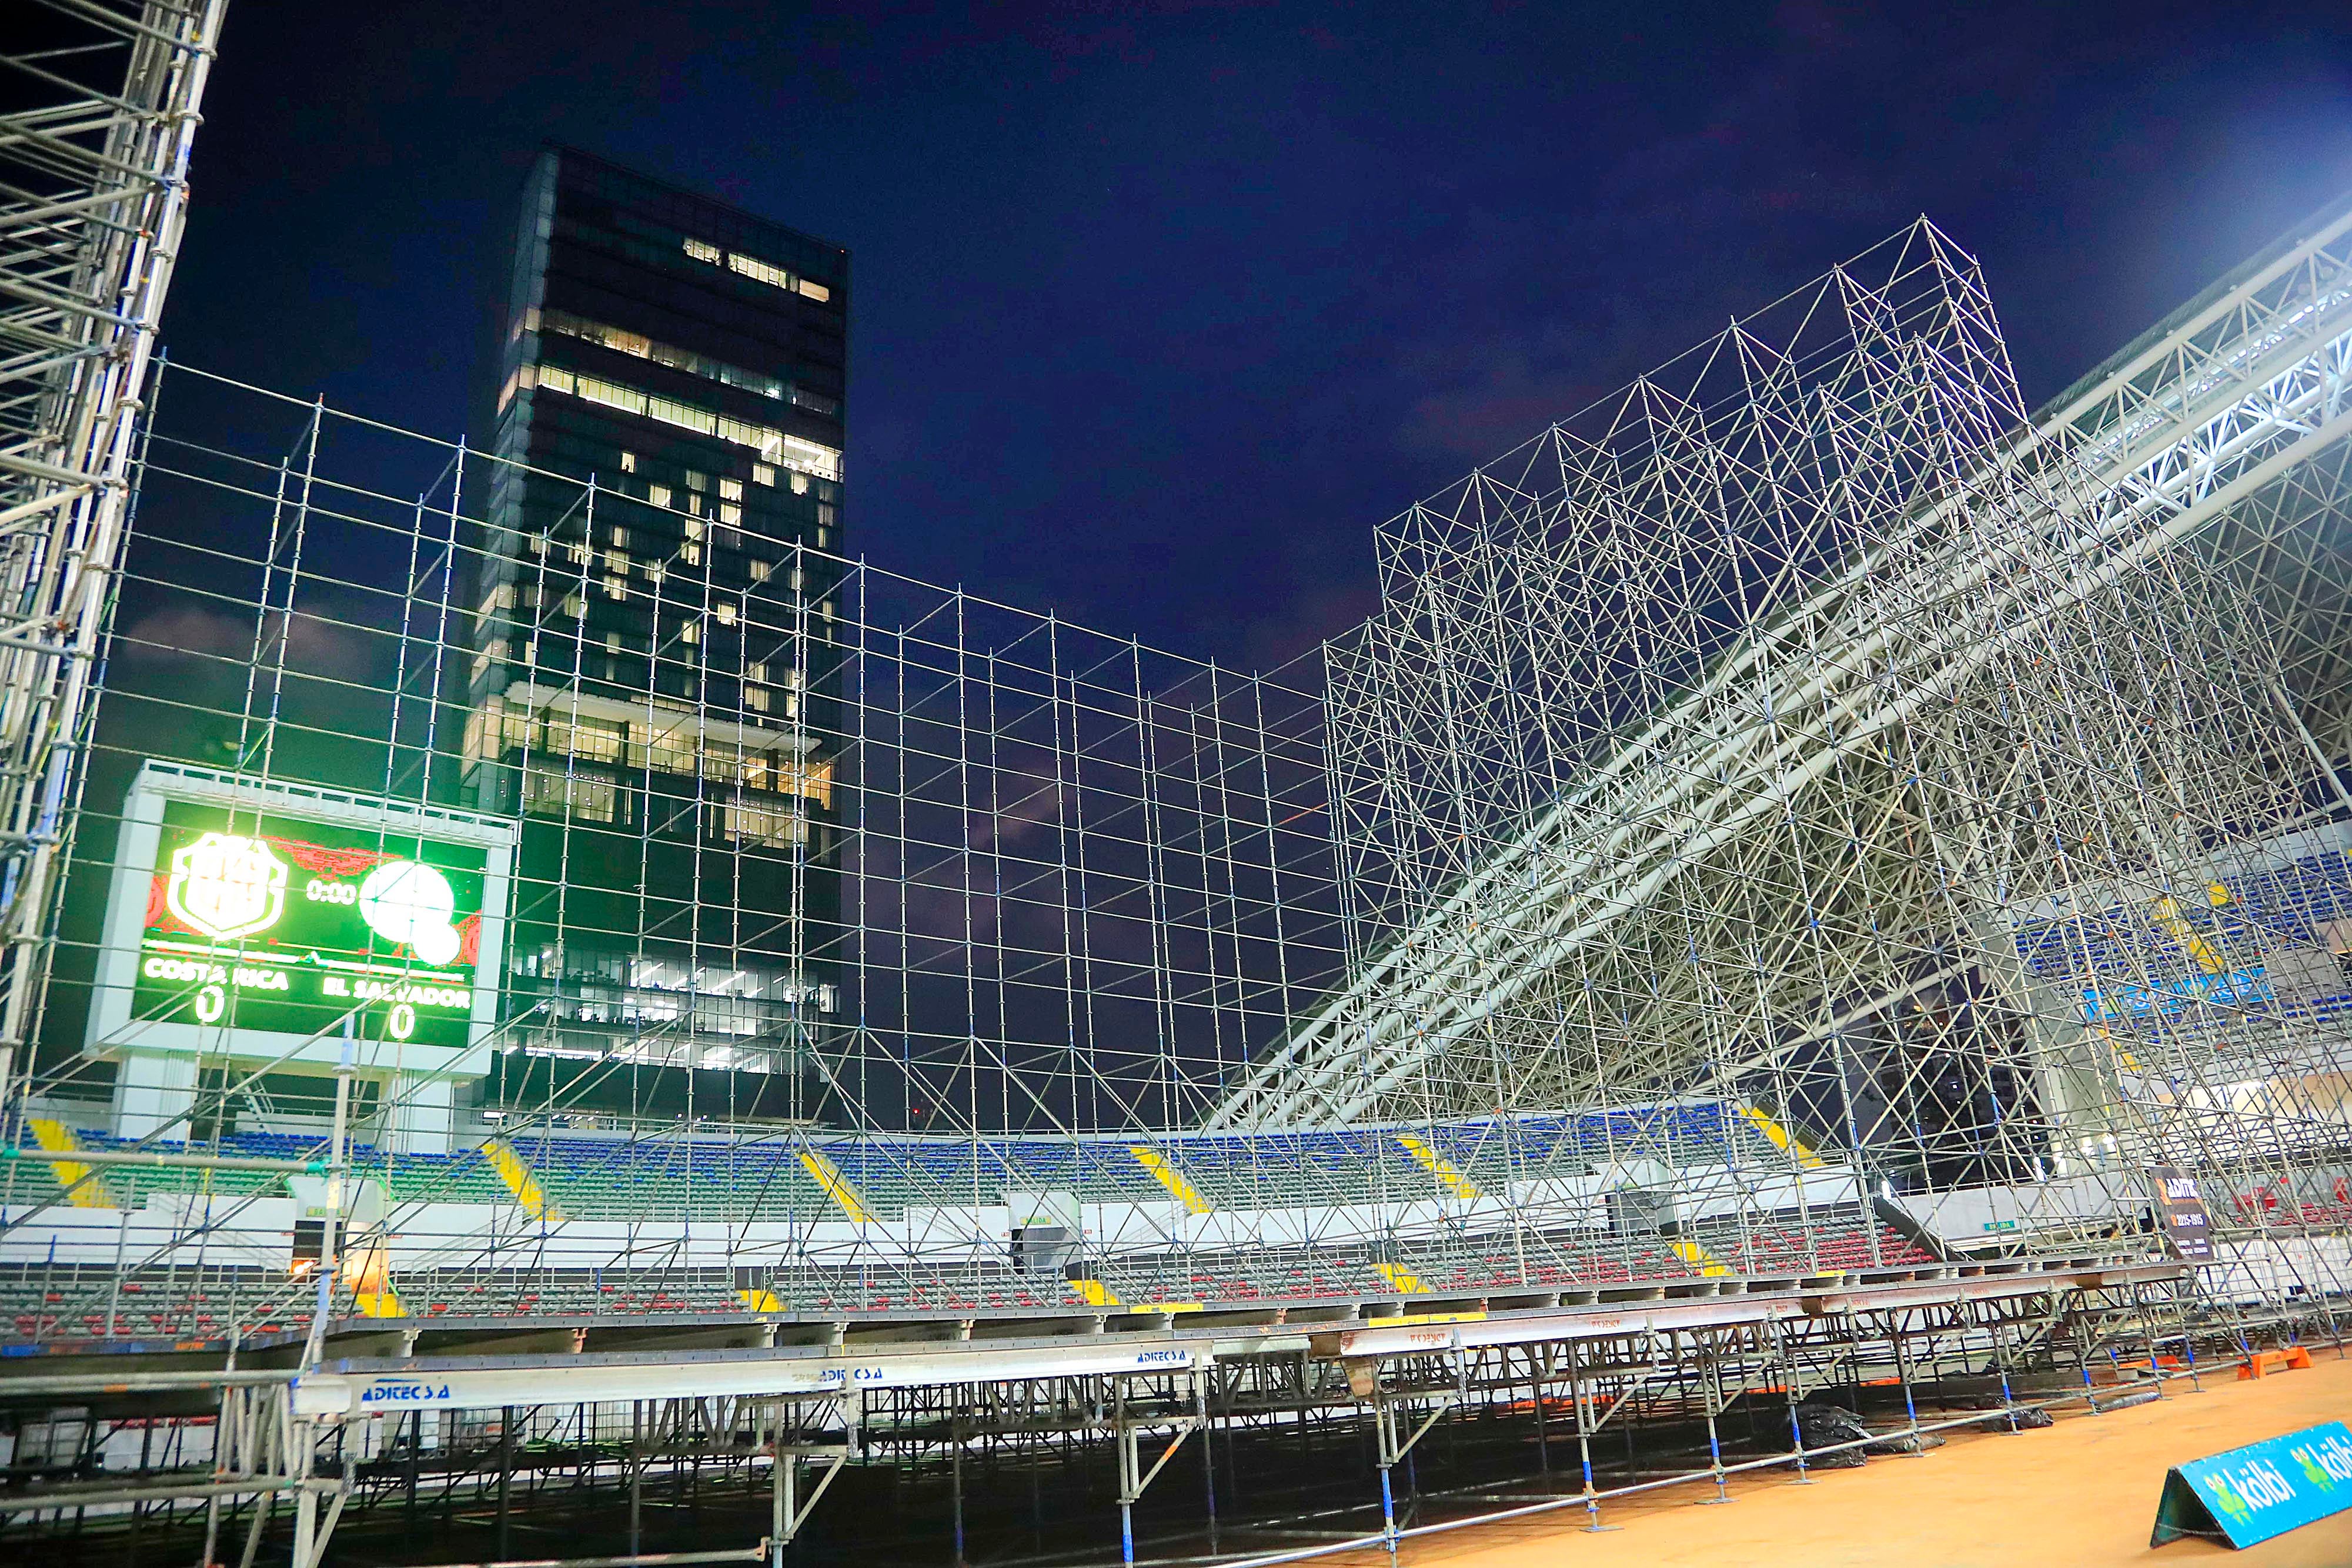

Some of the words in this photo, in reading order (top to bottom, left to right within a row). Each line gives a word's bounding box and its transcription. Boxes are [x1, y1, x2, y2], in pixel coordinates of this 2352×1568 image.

[306, 880, 357, 905] 0:00
[145, 958, 228, 985] COSTA
[232, 968, 289, 991] RICA
[196, 985, 225, 1022] 0
[323, 977, 350, 997] EL
[353, 979, 471, 1009] SALVADOR
[390, 1004, 415, 1039] 0
[1137, 1351, 1170, 1363] ADITEC
[362, 1386, 420, 1401] ADITEC
[2223, 1459, 2297, 1512] kölbi
